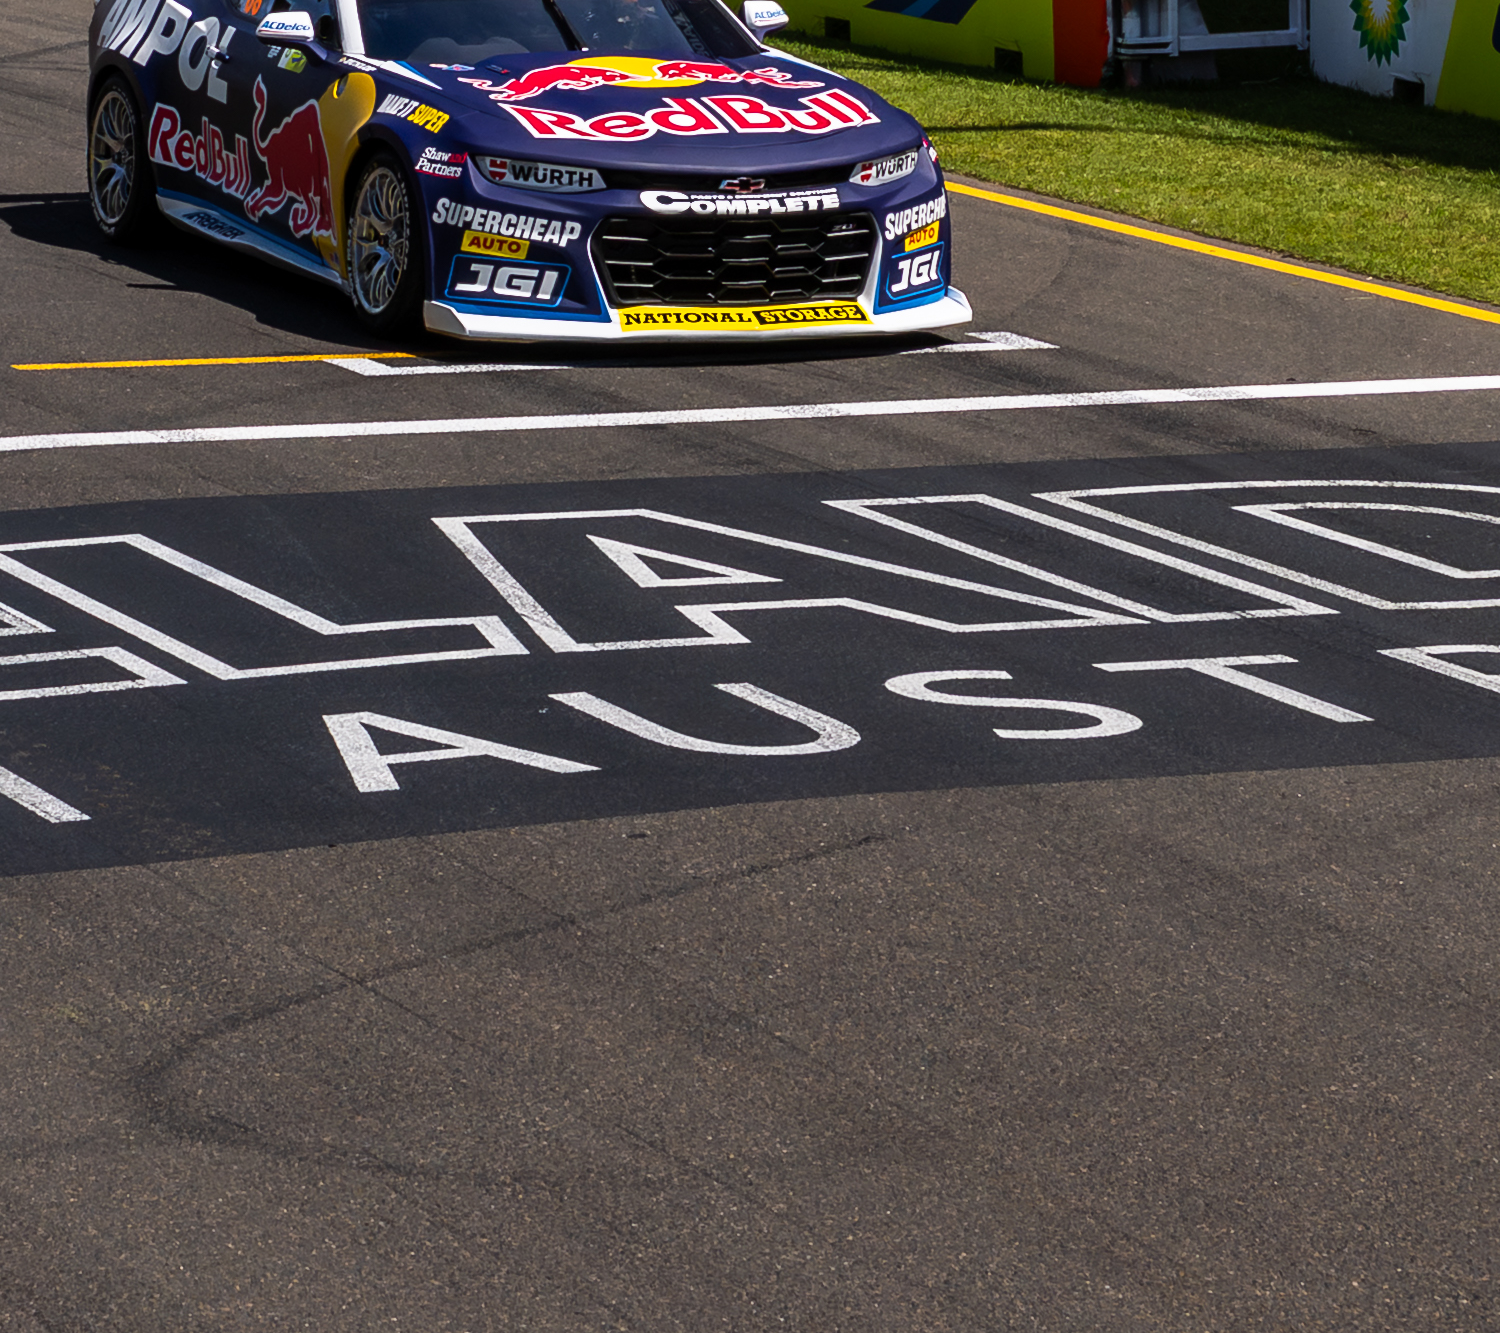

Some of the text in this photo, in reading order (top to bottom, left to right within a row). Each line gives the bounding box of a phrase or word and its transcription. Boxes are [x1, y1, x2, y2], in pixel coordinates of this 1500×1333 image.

[261, 20, 311, 32] ACDelco
[406, 103, 450, 133] SUPER
[422, 147, 451, 162] Shaw
[415, 158, 462, 178] Partners
[511, 164, 594, 187] WÜRTH
[873, 154, 919, 179] WÜRTH
[639, 190, 840, 215] COMPLETE
[432, 197, 582, 248] SUPERCHEAP
[467, 235, 522, 253] AUTO
[908, 228, 935, 246] AUTO
[454, 263, 559, 300] JGI
[891, 253, 940, 293] JGI
[624, 305, 865, 326] NATIONAL STORAGE
